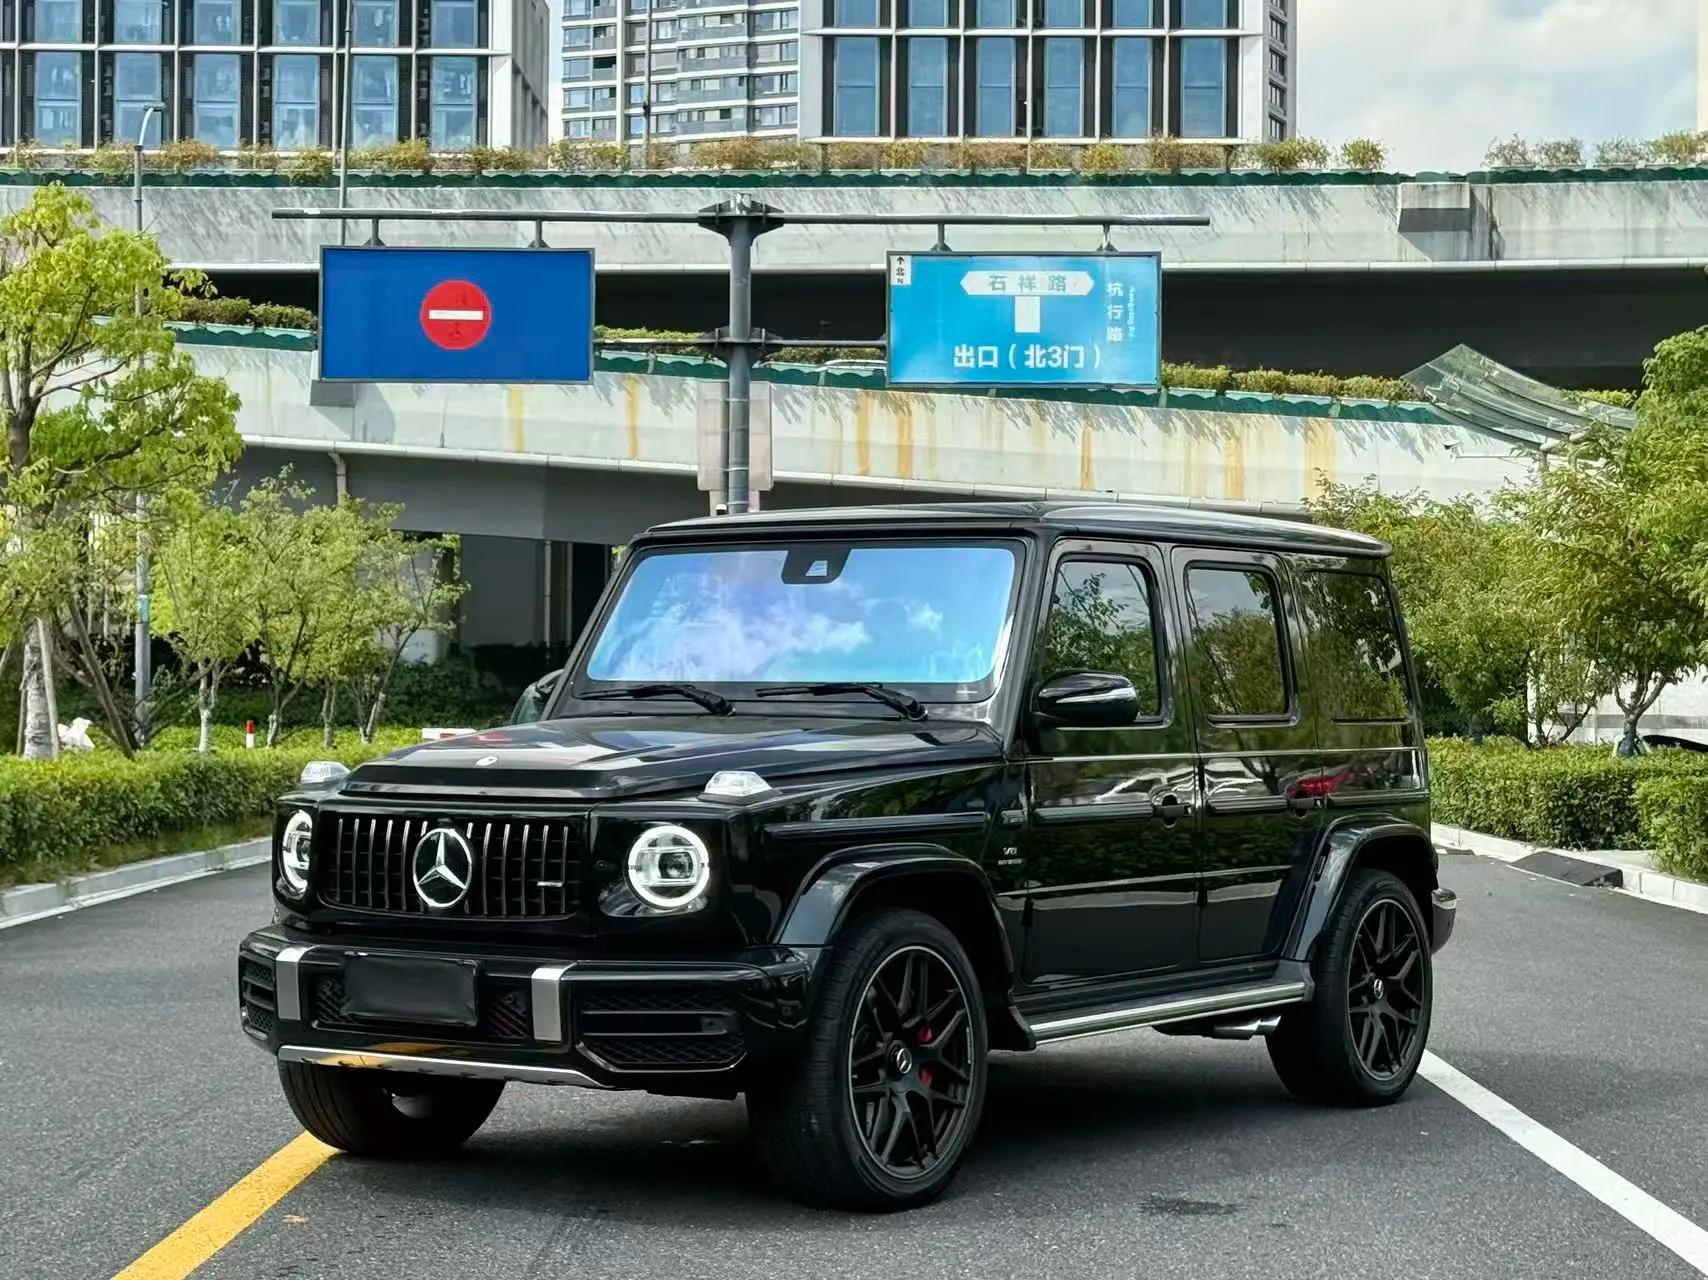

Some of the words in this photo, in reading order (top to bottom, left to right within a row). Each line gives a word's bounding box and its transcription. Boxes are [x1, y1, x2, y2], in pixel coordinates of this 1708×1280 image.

[895, 266, 905, 276] 北
[988, 274, 1067, 291] 石祥路
